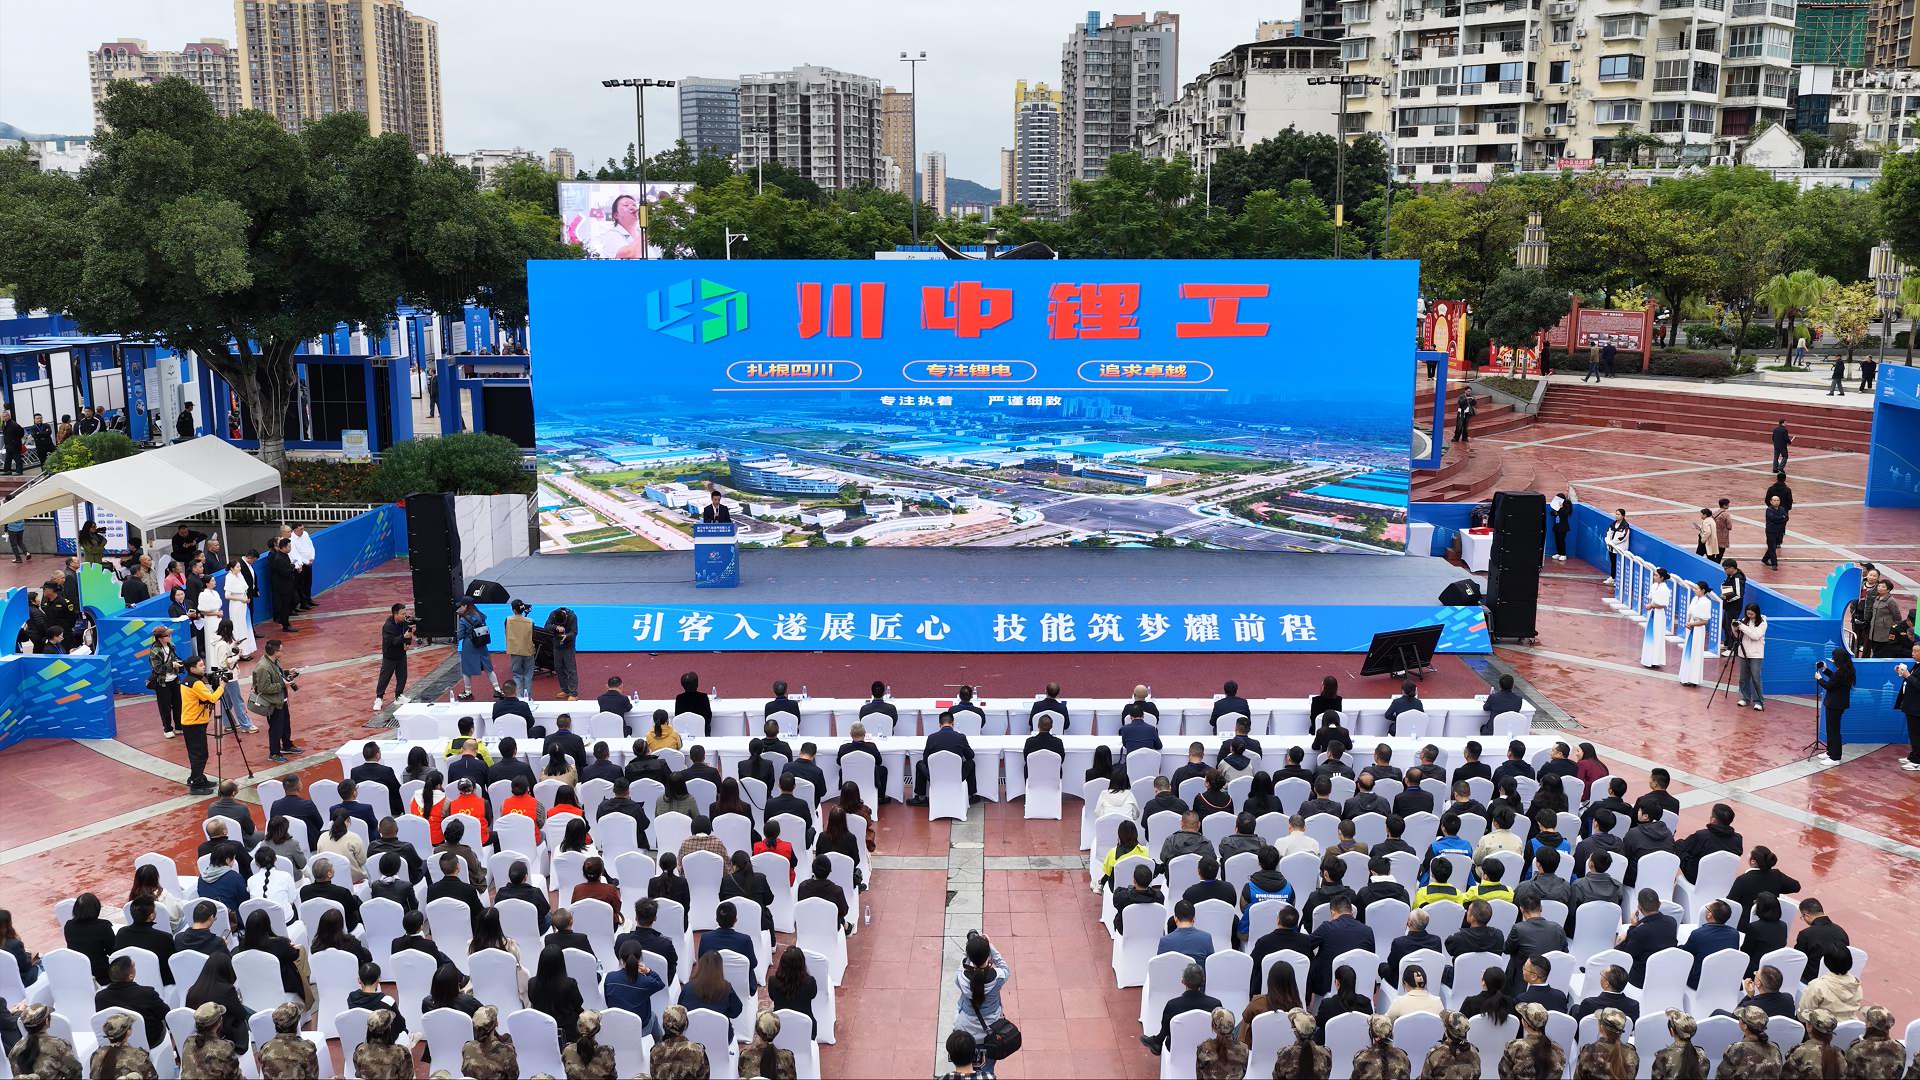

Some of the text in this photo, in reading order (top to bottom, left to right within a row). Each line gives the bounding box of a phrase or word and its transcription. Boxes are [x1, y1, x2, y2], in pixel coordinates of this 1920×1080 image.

[797, 282, 1270, 339] 川中锂工
[746, 363, 834, 378] 扎根四川
[925, 363, 1012, 378] 专注锂电
[1099, 363, 1188, 379] 追求卓越
[879, 395, 1063, 407] 专注执着 严谨细致
[631, 612, 1320, 643] 引客入遂展匠心 技能筑梦耀前程
